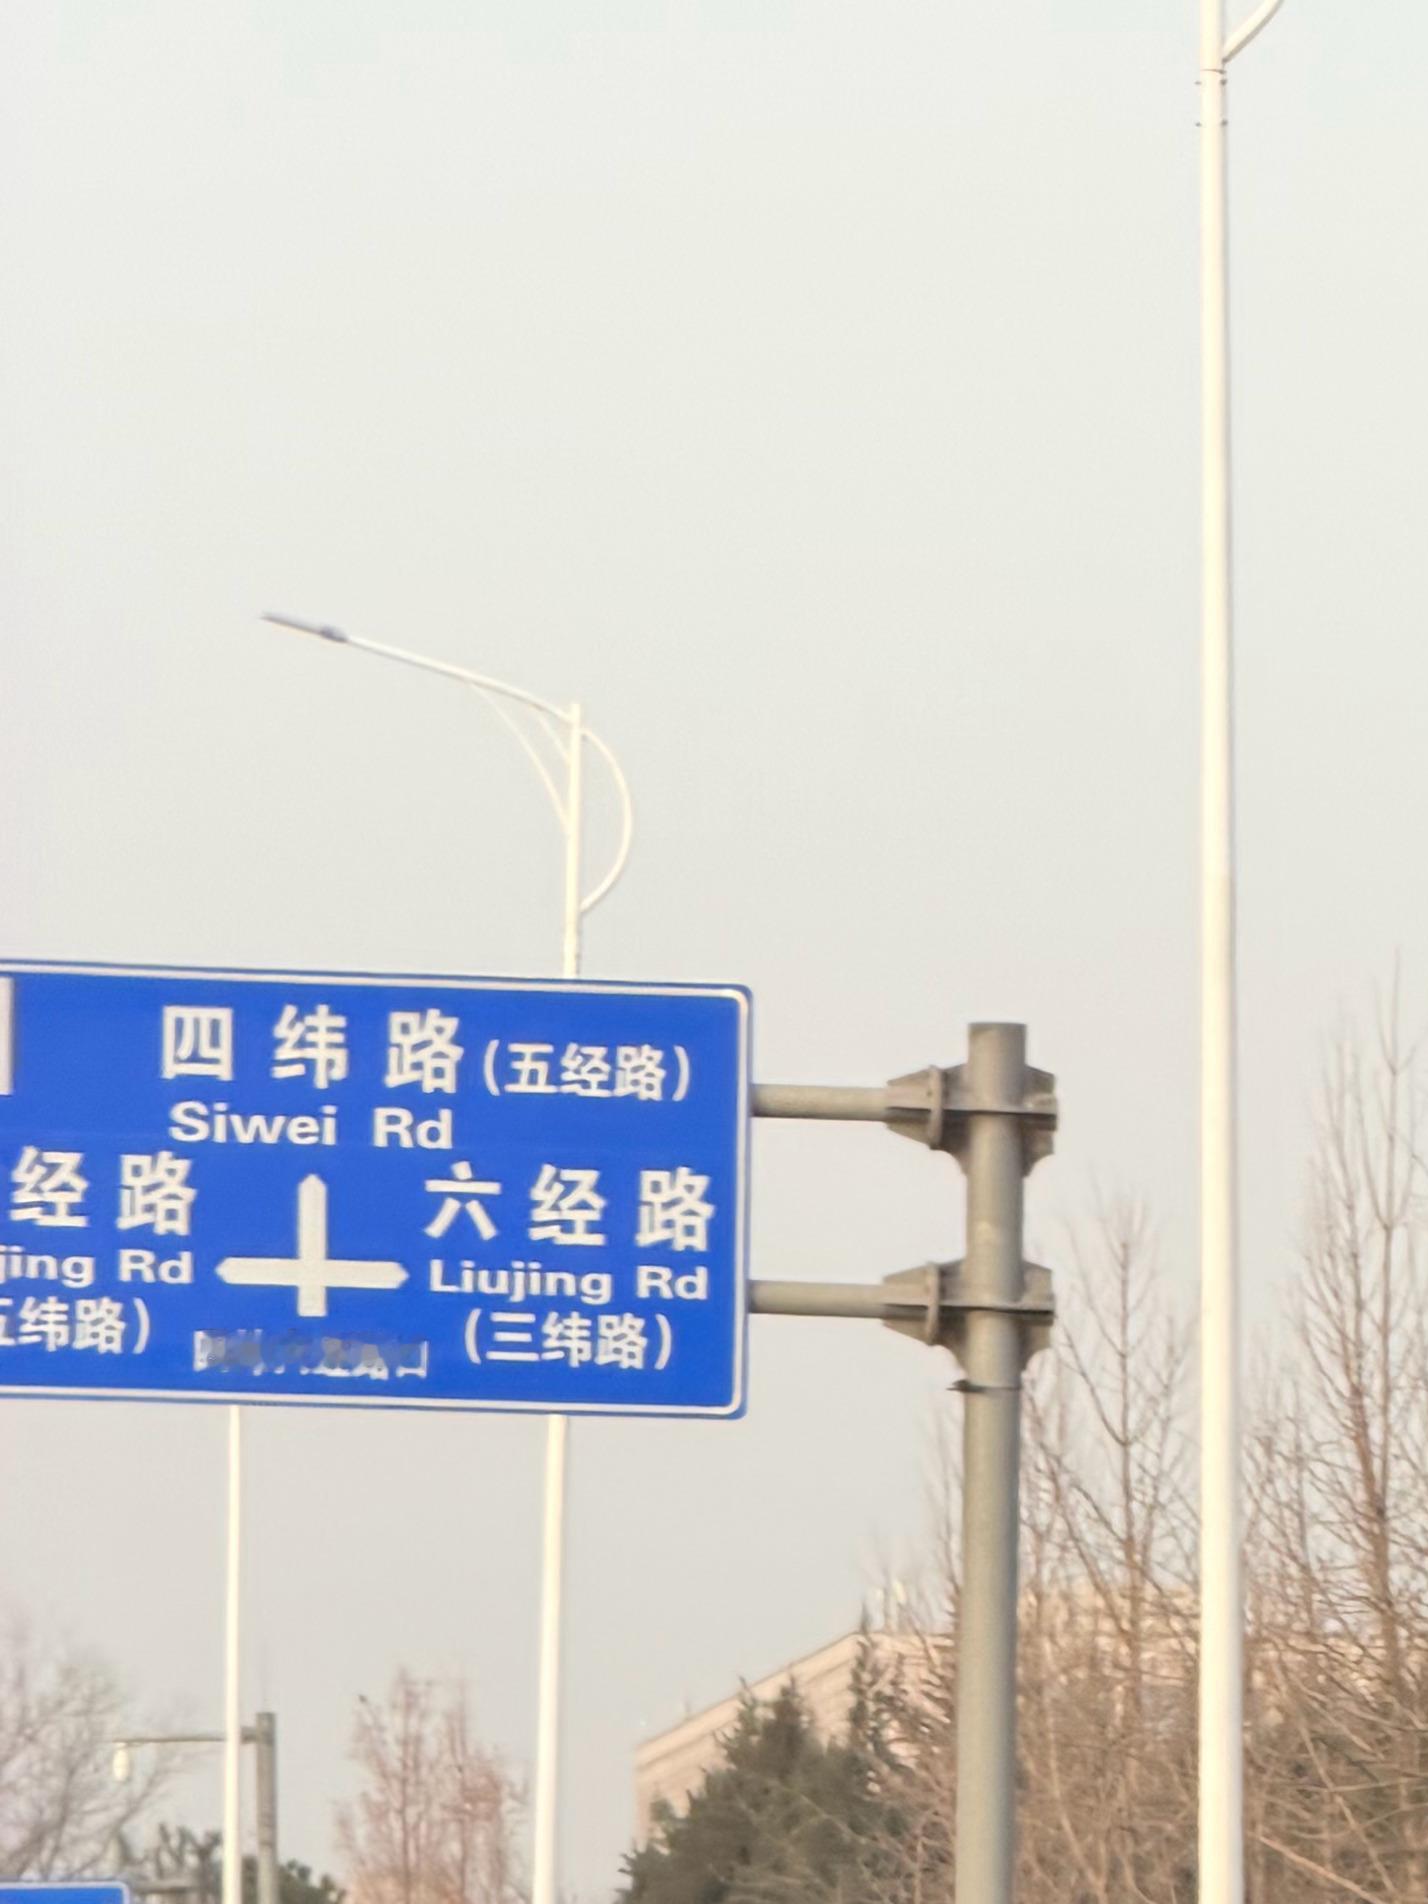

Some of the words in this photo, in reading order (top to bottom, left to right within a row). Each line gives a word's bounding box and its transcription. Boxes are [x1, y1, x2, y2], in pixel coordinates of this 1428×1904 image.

[161, 1003, 464, 1094] 四纬路
[484, 1038, 690, 1102] (五经路)
[168, 1100, 338, 1146] Siwei
[373, 1107, 453, 1150] Rd
[10, 1144, 199, 1237] 经路
[424, 1160, 716, 1253] 六经路
[119, 1248, 193, 1285] Rd
[430, 1258, 613, 1303] Liujing
[636, 1265, 709, 1301] Rd
[465, 1307, 673, 1370] (三纬路)
